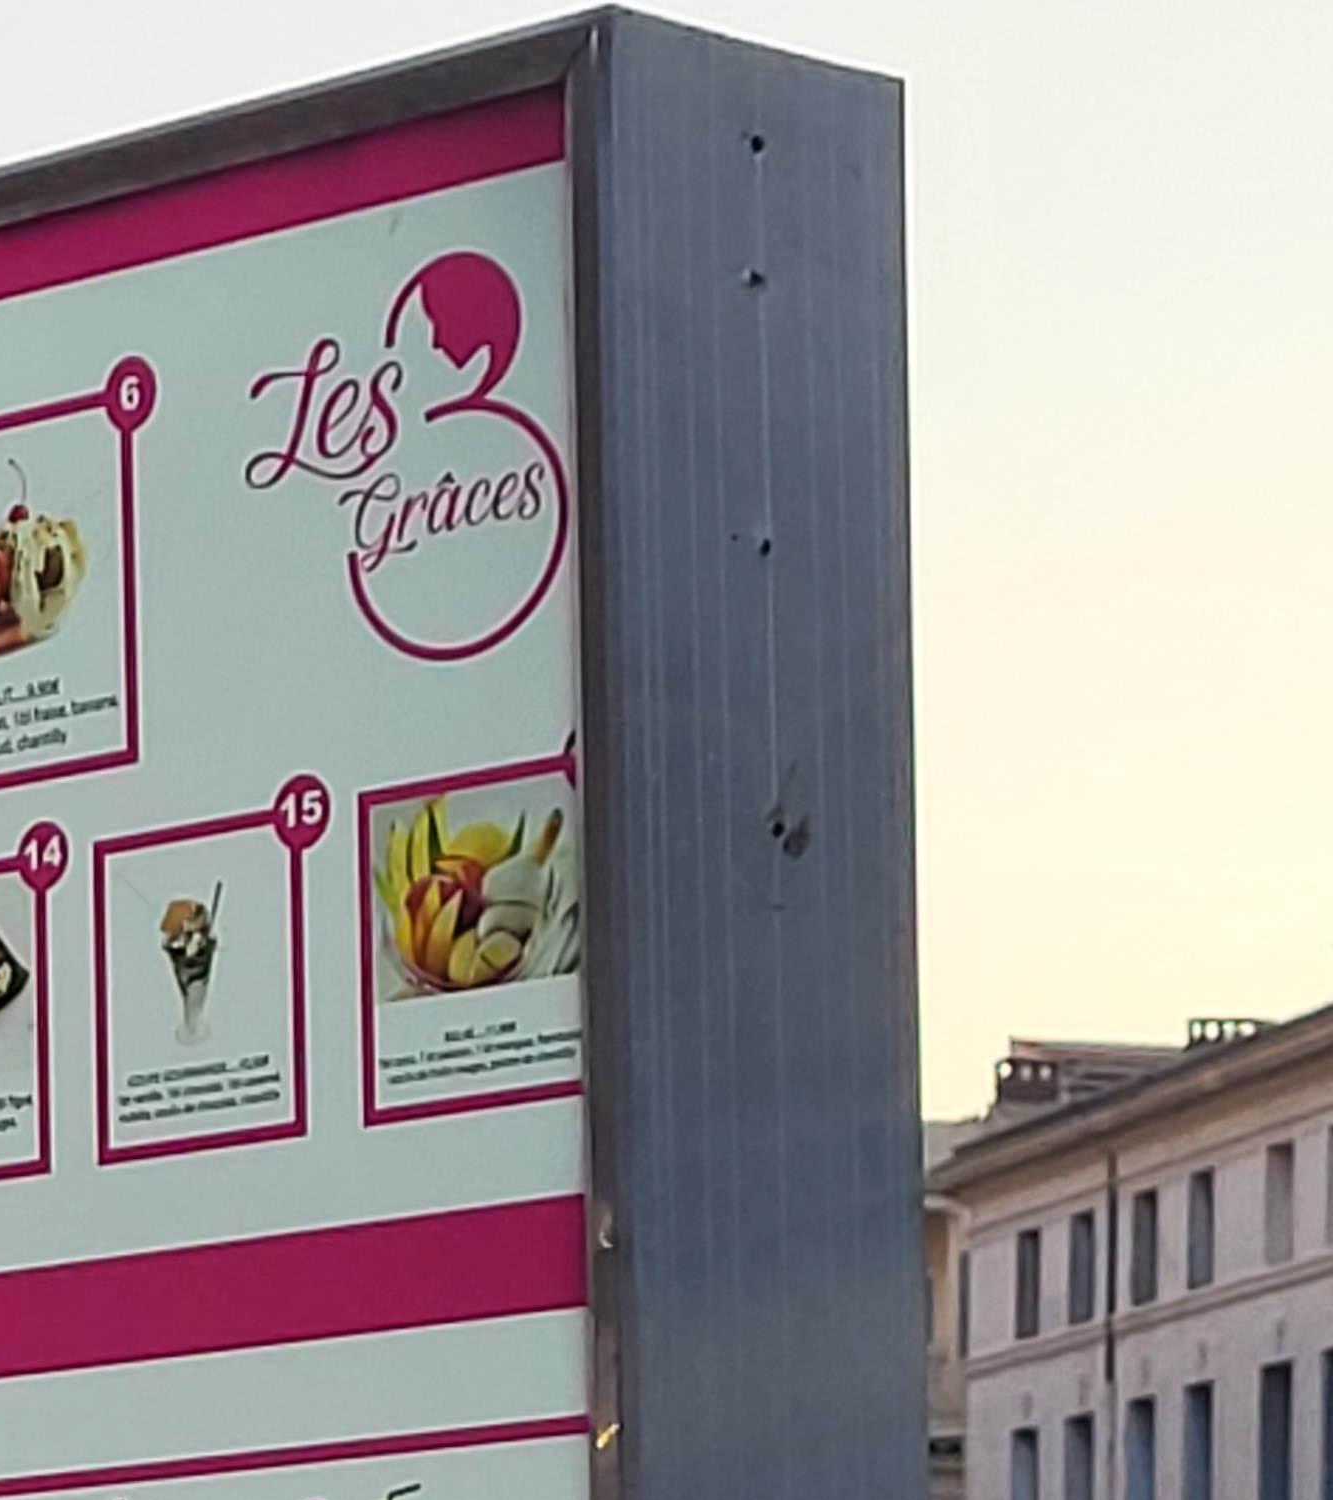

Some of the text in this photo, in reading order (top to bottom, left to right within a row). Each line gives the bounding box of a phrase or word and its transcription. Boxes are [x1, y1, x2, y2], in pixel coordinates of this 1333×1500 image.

[120, 375, 140, 411] 6
[245, 338, 403, 490] Les
[338, 462, 545, 574] Grâces
[281, 790, 323, 827] 15
[24, 836, 60, 869] 14
